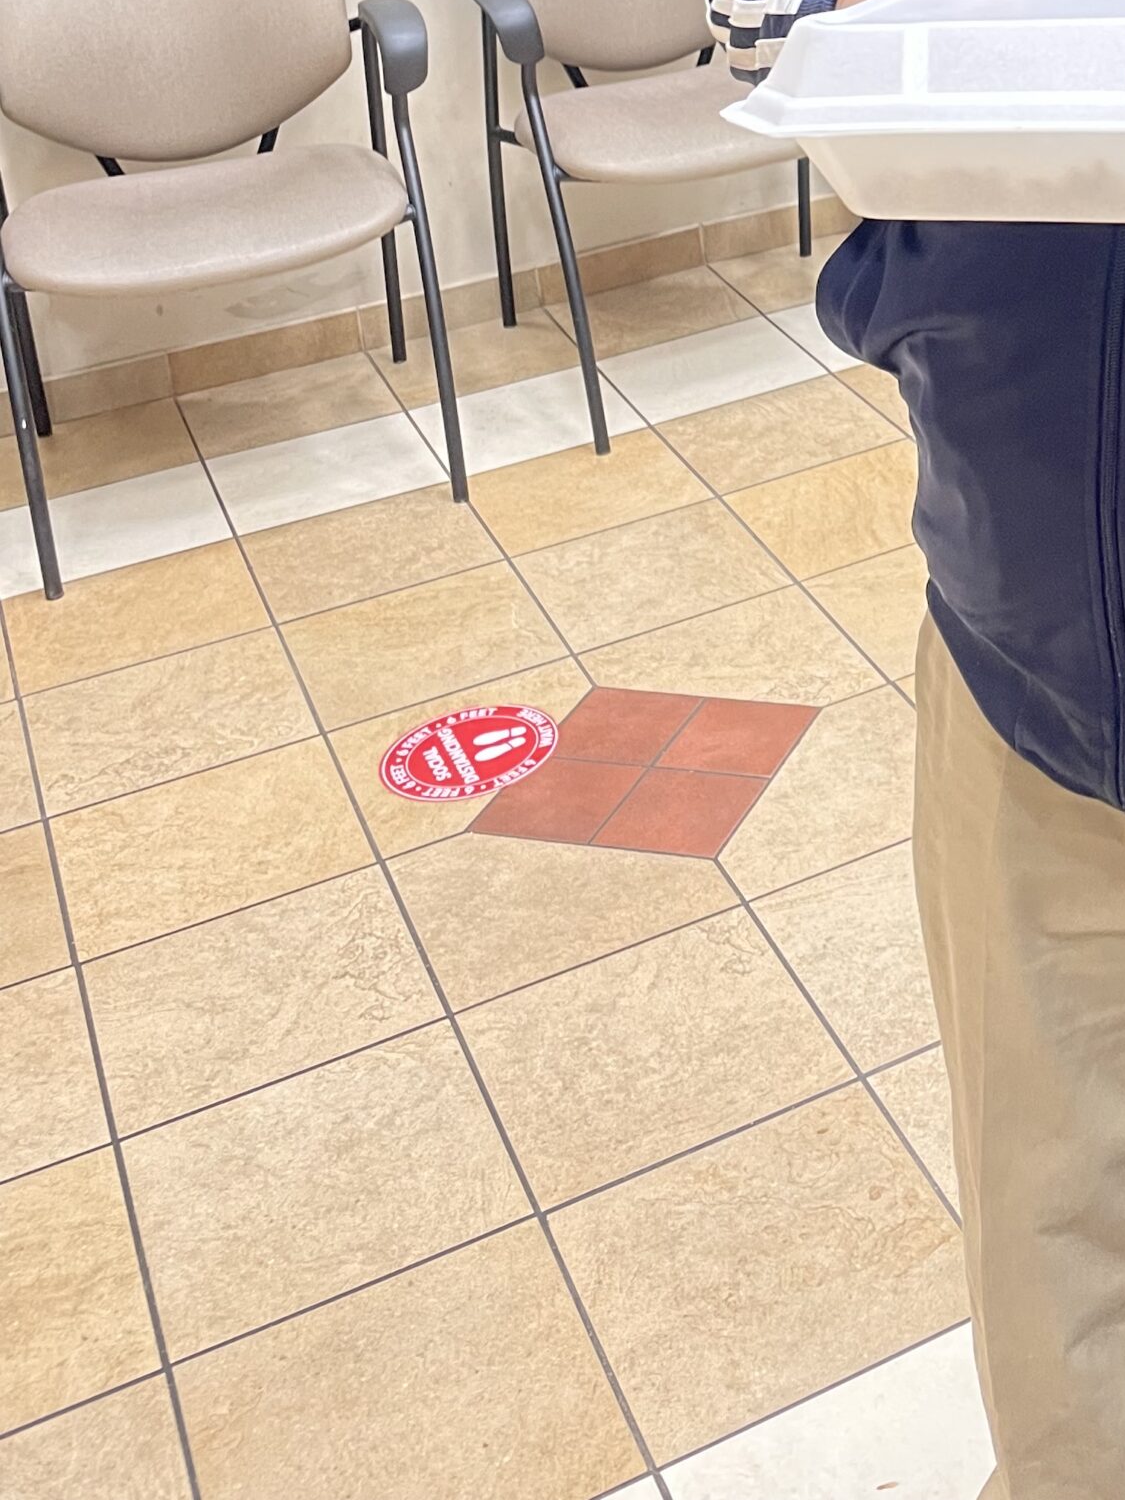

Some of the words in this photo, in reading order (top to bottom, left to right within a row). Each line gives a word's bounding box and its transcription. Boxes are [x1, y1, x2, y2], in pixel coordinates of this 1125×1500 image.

[459, 707, 498, 719] FEET
[422, 745, 452, 782] SOCIAL
[437, 726, 480, 785] DISTANCING
[421, 786, 461, 798] FEET
